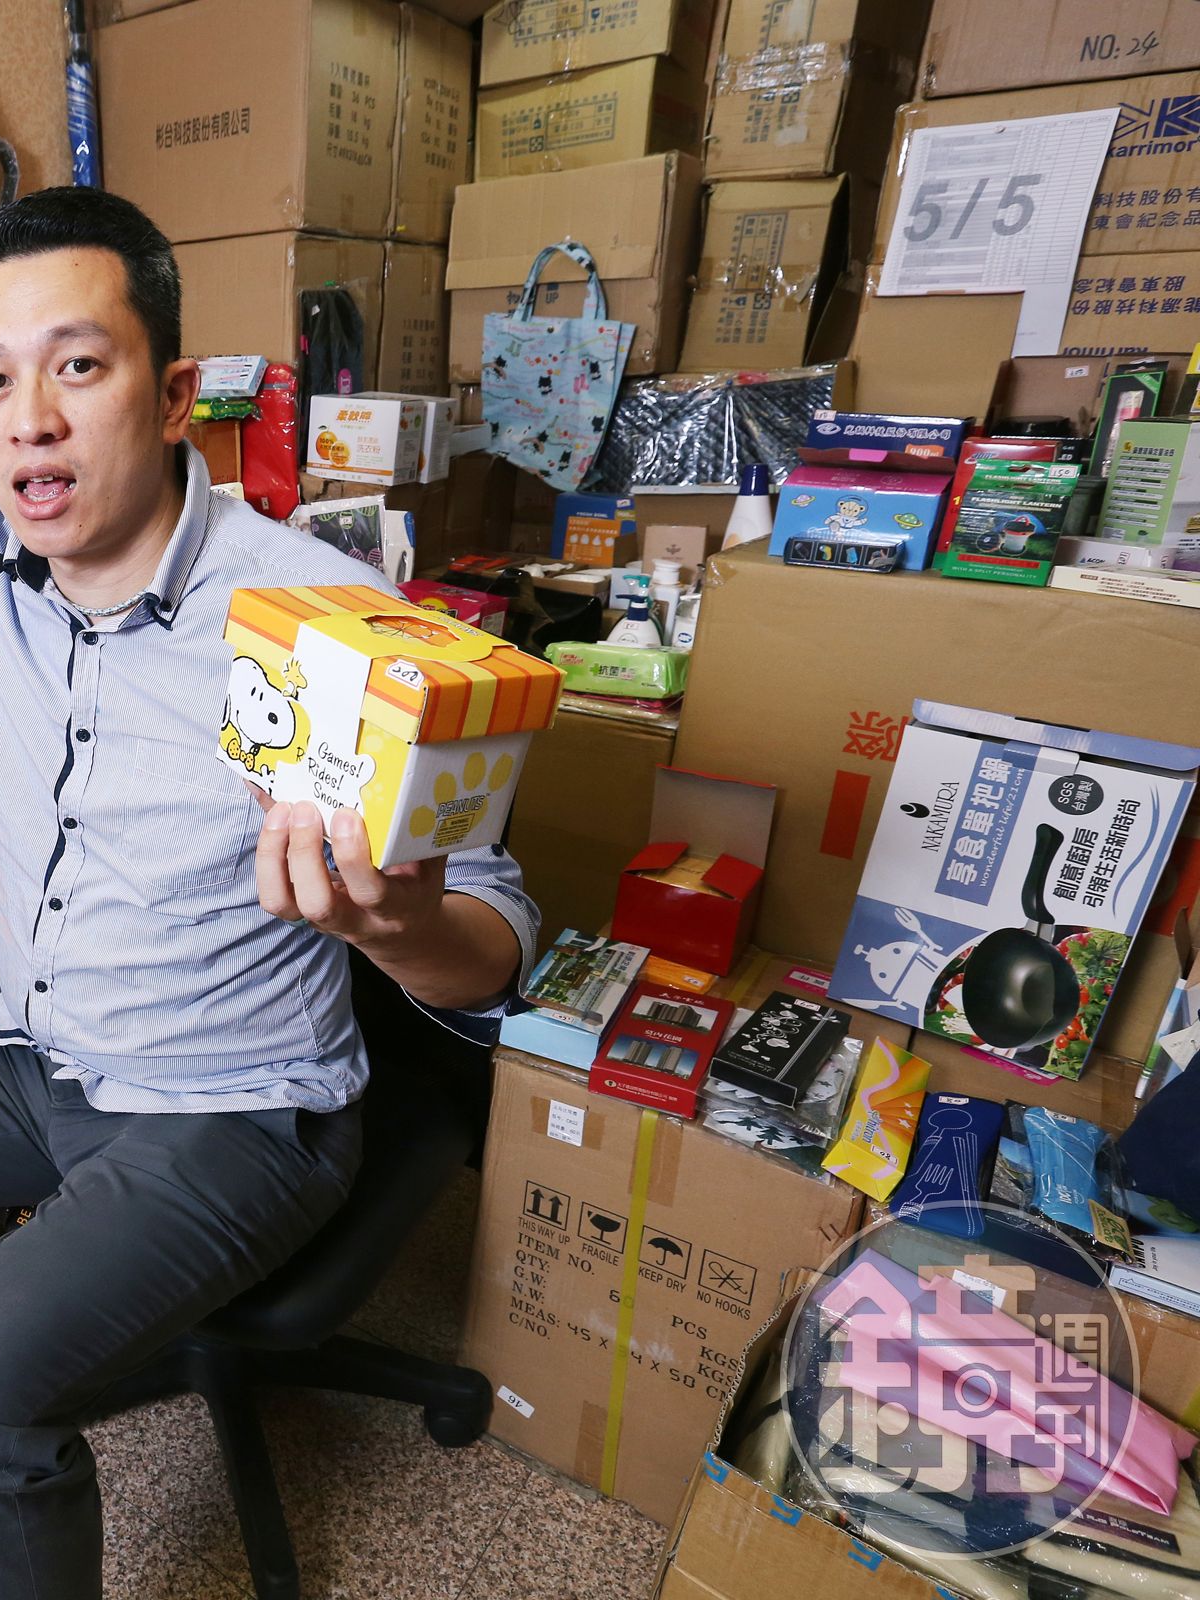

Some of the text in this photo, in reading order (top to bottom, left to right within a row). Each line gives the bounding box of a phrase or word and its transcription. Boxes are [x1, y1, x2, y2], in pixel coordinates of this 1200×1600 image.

[971, 496, 1063, 509] FLASHLIGHT LANTERN
[307, 756, 345, 791] Rides!
[318, 741, 364, 779] Games!
[436, 794, 486, 818] PEANUTS
[1057, 781, 1076, 804] SGS
[1071, 780, 1095, 812] 台灣製
[920, 779, 961, 853] NAKAMURA
[946, 755, 1015, 888] 享食單把鍋
[979, 825, 1006, 888] wonderful
[1053, 826, 1100, 901] 創意廚房
[1081, 798, 1142, 908] 引領生活新時尚
[517, 1217, 571, 1246] THIS WAY UP
[517, 1231, 596, 1276] ITEM NO.
[581, 1243, 620, 1267] FRAGILE
[515, 1249, 550, 1274] QTY:
[671, 1314, 708, 1341] PCS
[638, 1266, 687, 1293] KEEP DRY
[513, 1265, 739, 1372] G.W: KGS
[696, 1290, 751, 1321] NO HOOKS
[508, 1311, 551, 1341] C/NO.
[509, 1296, 561, 1329] MEAS:
[567, 1321, 592, 1342] 45
[668, 1367, 697, 1390] 50
[512, 1280, 736, 1387] N.W: KGS
